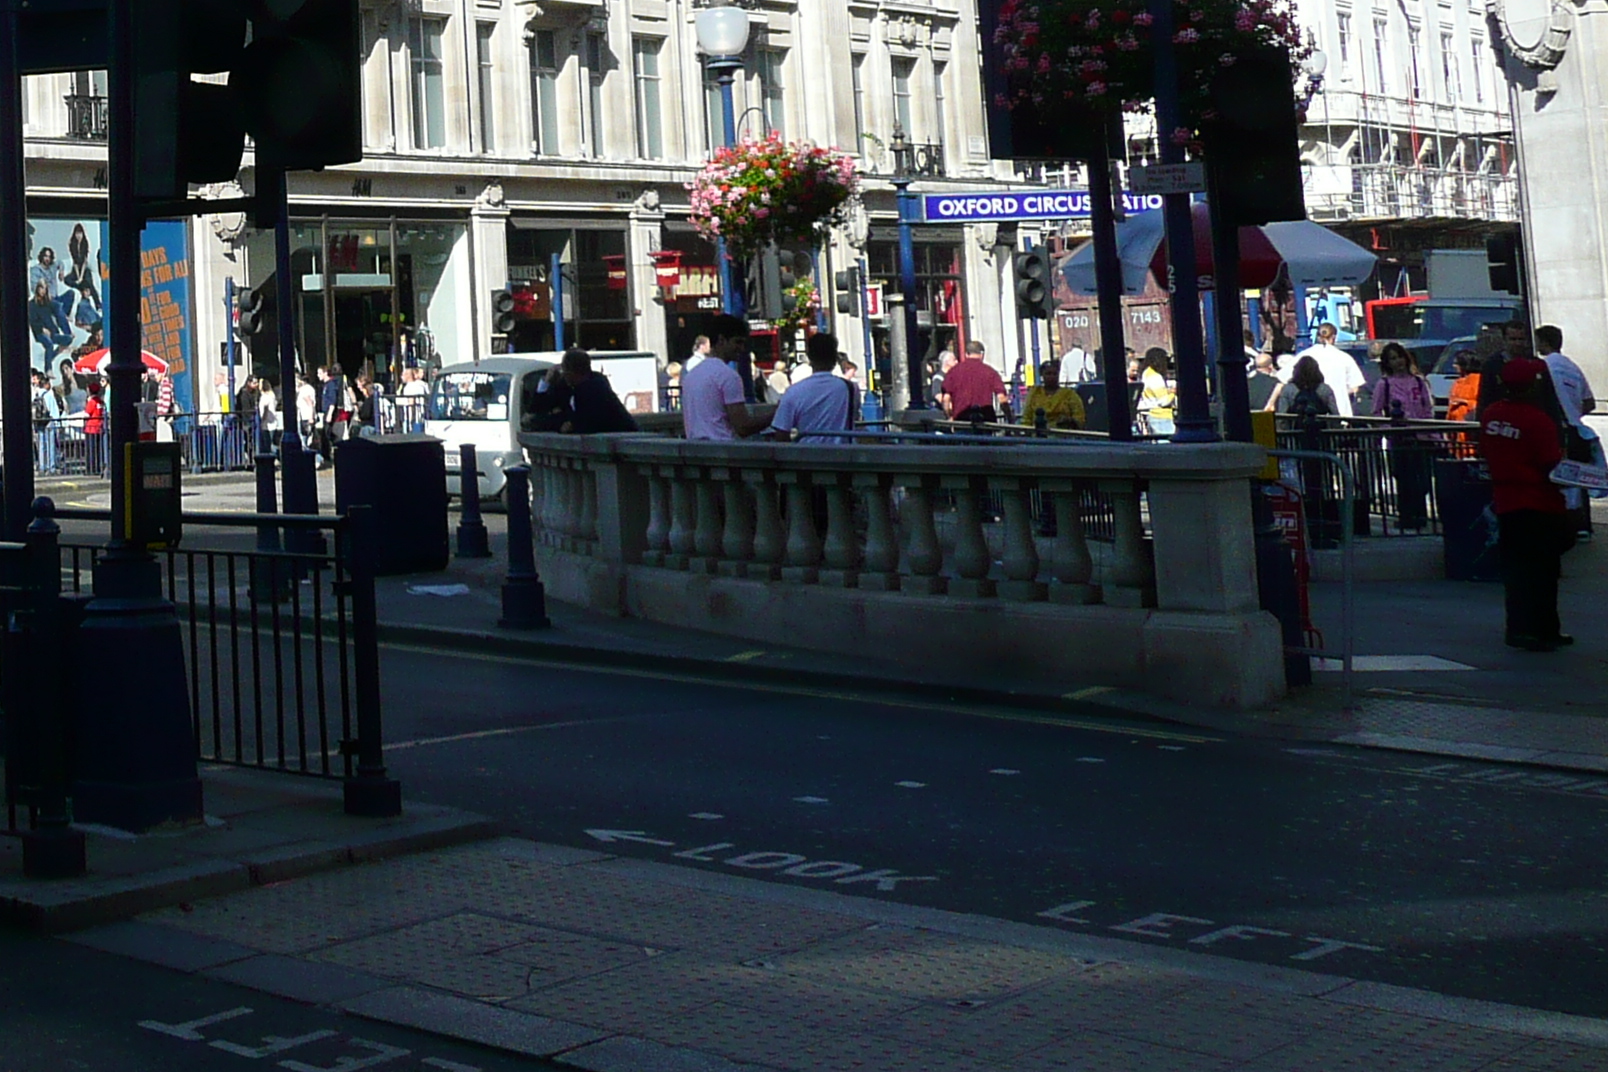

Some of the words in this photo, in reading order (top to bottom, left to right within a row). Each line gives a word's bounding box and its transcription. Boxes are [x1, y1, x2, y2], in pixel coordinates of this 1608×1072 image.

[938, 197, 1018, 216] OXFORD
[1023, 194, 1091, 213] CIRCUS
[1065, 316, 1089, 328] 020
[1130, 311, 1161, 324] 7143
[1486, 421, 1520, 439] Sun
[674, 840, 940, 891] LOOK
[1037, 899, 1386, 961] LEFT
